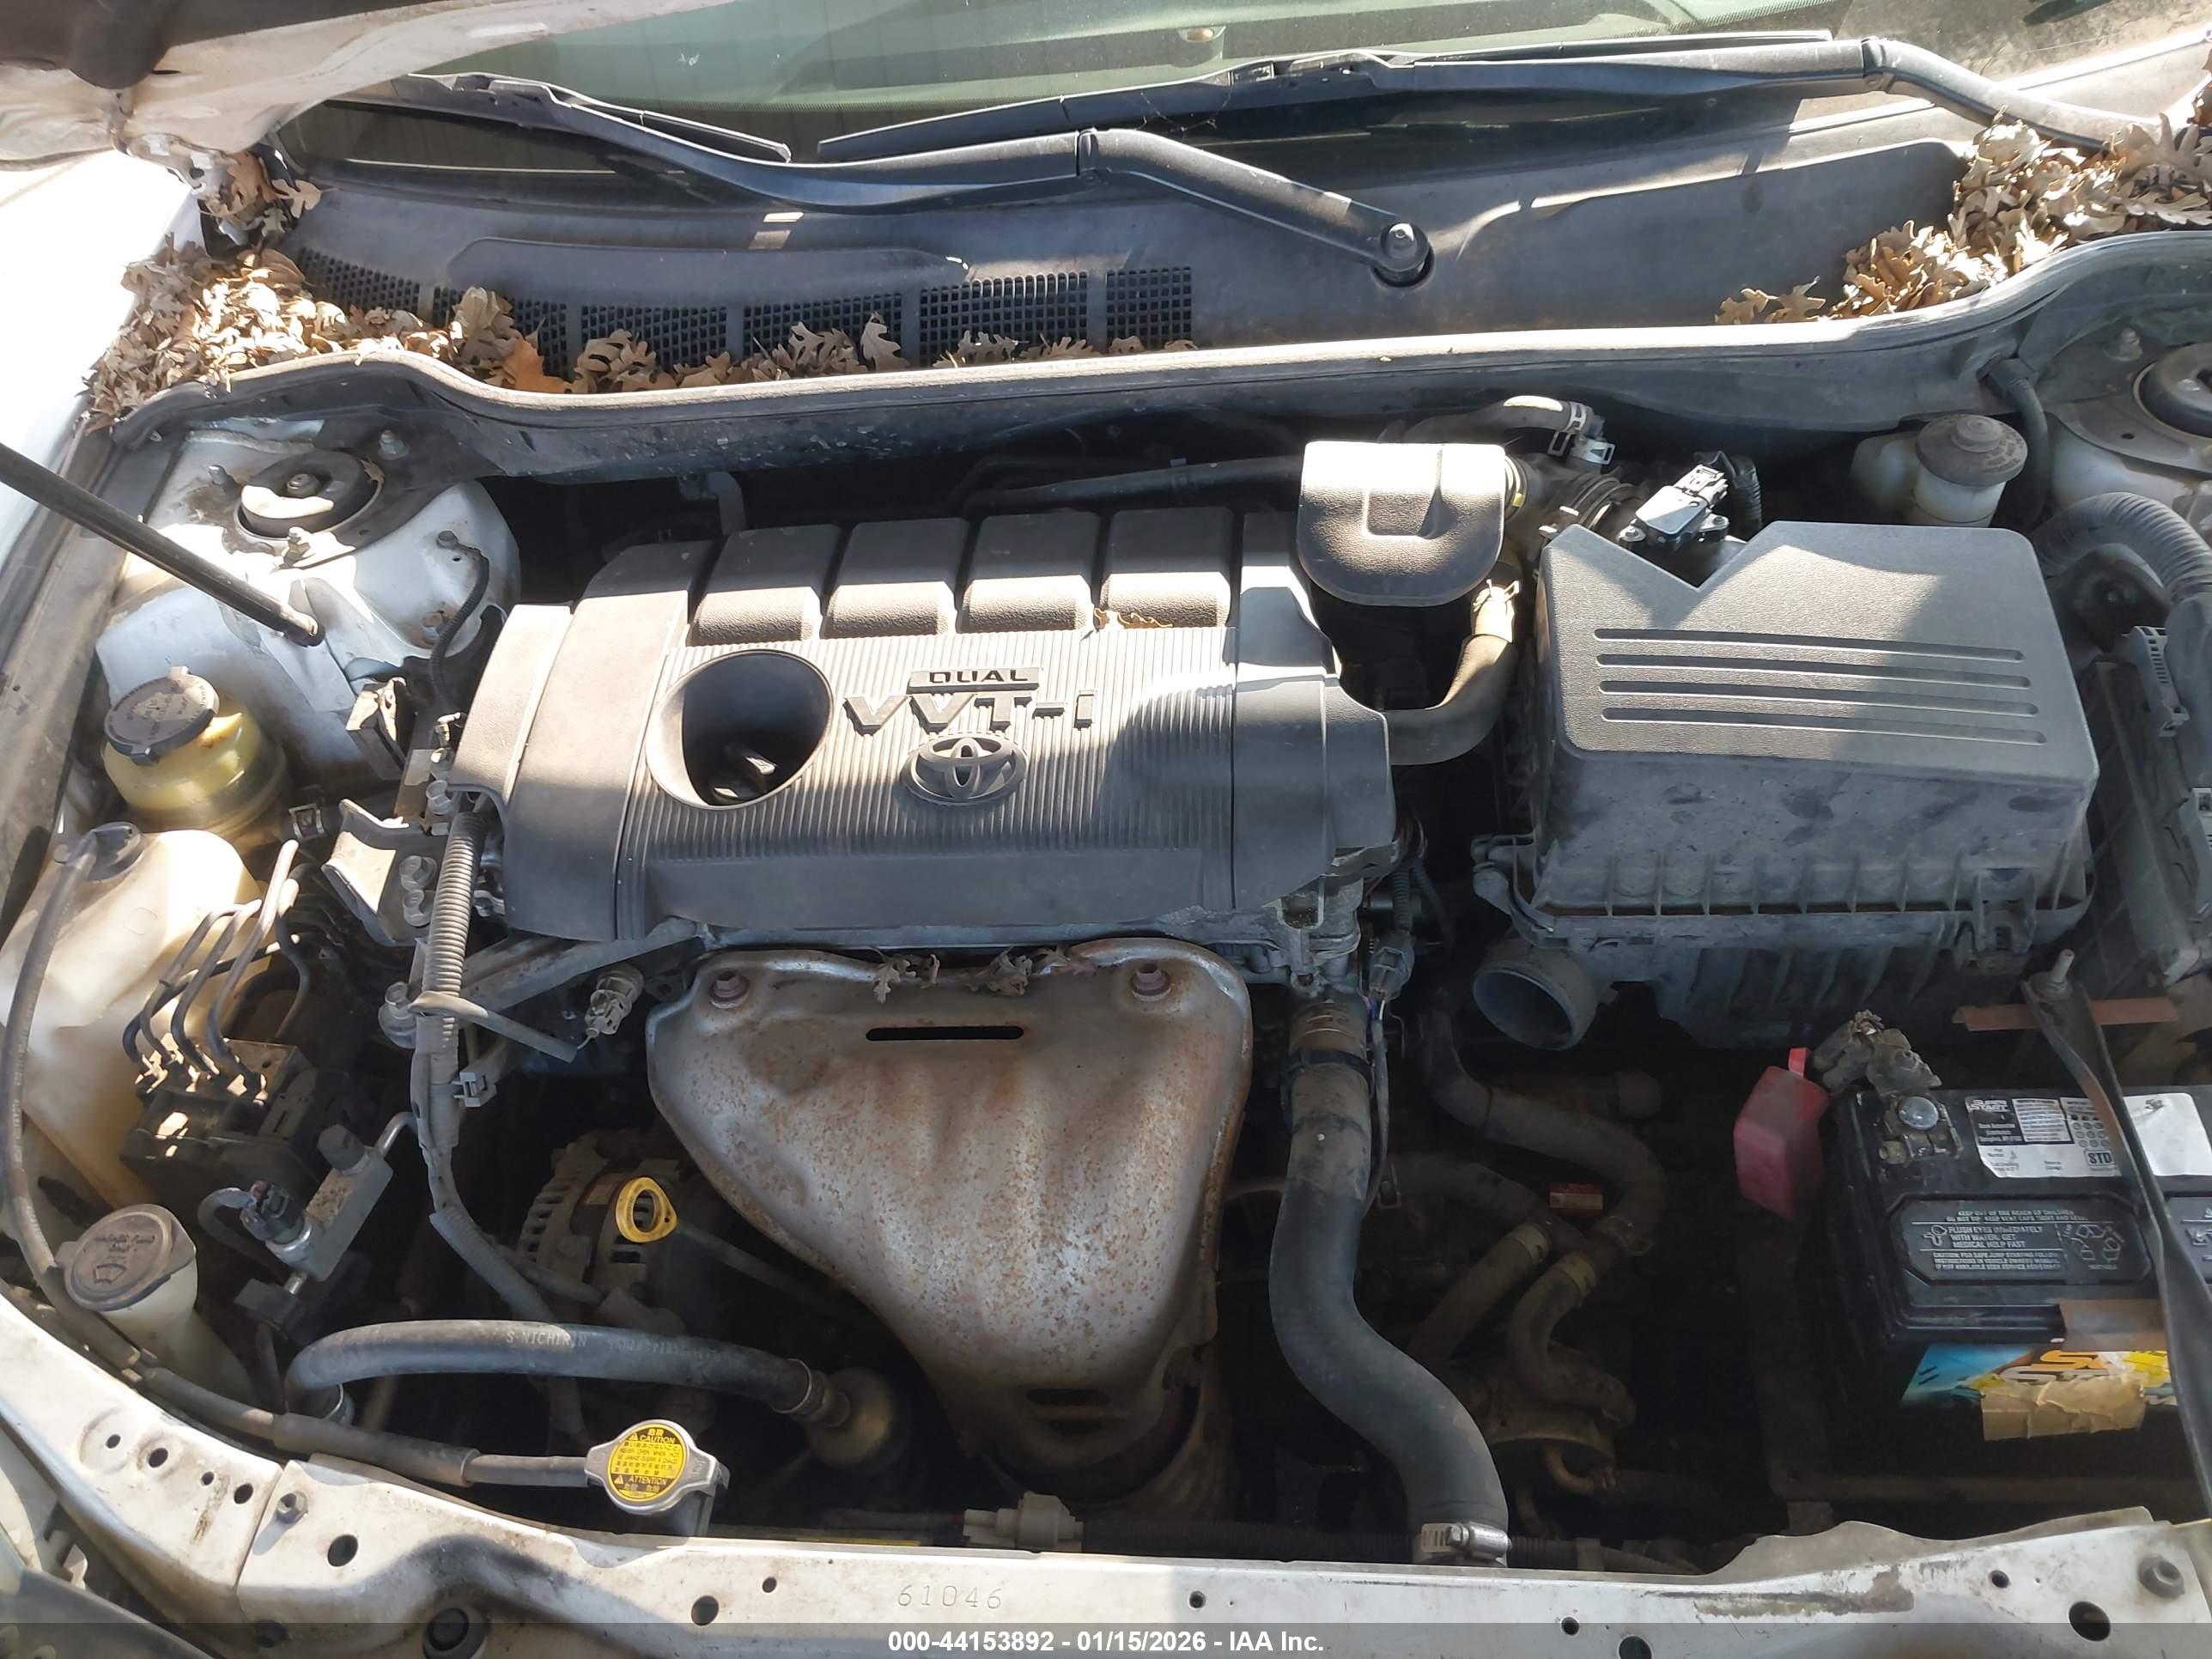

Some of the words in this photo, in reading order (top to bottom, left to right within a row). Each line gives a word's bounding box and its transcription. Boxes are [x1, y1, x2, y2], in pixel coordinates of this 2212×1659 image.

[929, 670, 1028, 684] DUAL
[2088, 1152, 2112, 1164] STD
[639, 1435, 675, 1444] CAUTION
[629, 1474, 667, 1485] ATTENTION
[897, 1584, 1002, 1609] 61046
